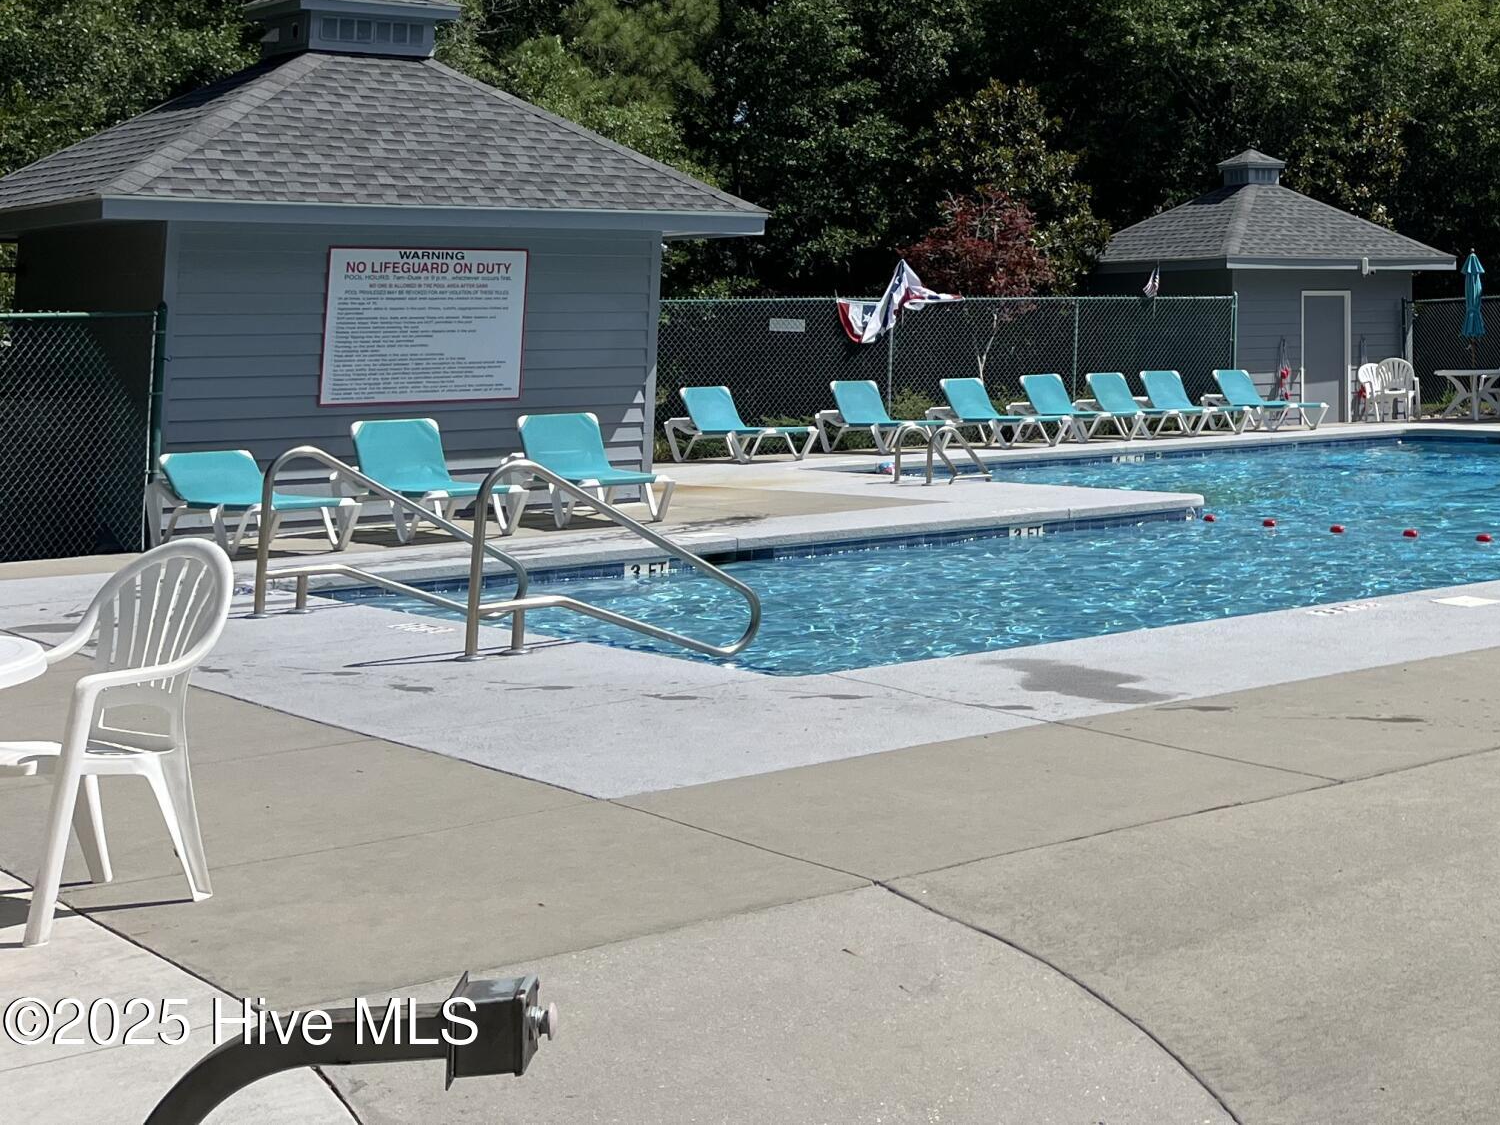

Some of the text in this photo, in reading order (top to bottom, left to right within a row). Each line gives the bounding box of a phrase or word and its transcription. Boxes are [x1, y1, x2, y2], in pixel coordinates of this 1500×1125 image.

[399, 251, 465, 260] WARNING
[346, 262, 512, 274] NO LIFEGUARD ON DUTY
[1028, 525, 1042, 536] FT
[630, 561, 667, 576] 3 FT
